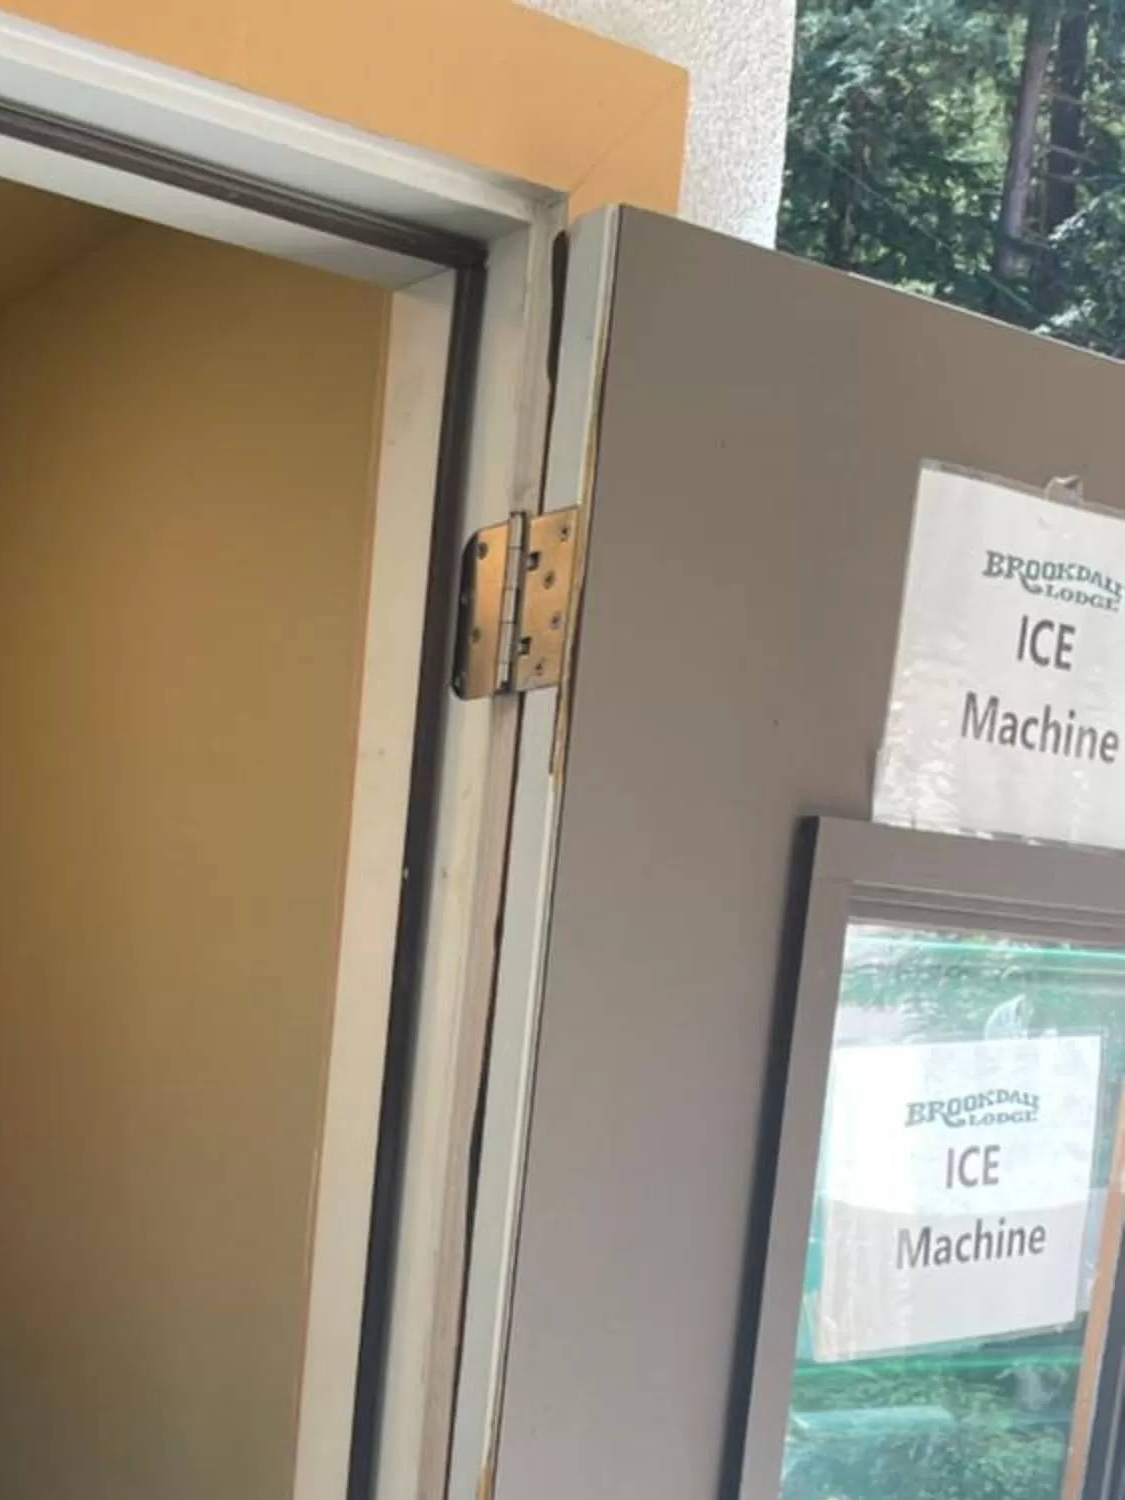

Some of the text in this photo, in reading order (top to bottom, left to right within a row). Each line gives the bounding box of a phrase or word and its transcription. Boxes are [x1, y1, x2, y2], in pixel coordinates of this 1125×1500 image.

[1044, 583, 1119, 612] LODGE
[1016, 614, 1076, 671] ICE
[961, 690, 1120, 764] Machine
[968, 1110, 1039, 1127] LODGE
[945, 1144, 1001, 1189] ICE
[895, 1217, 1046, 1270] Machine
